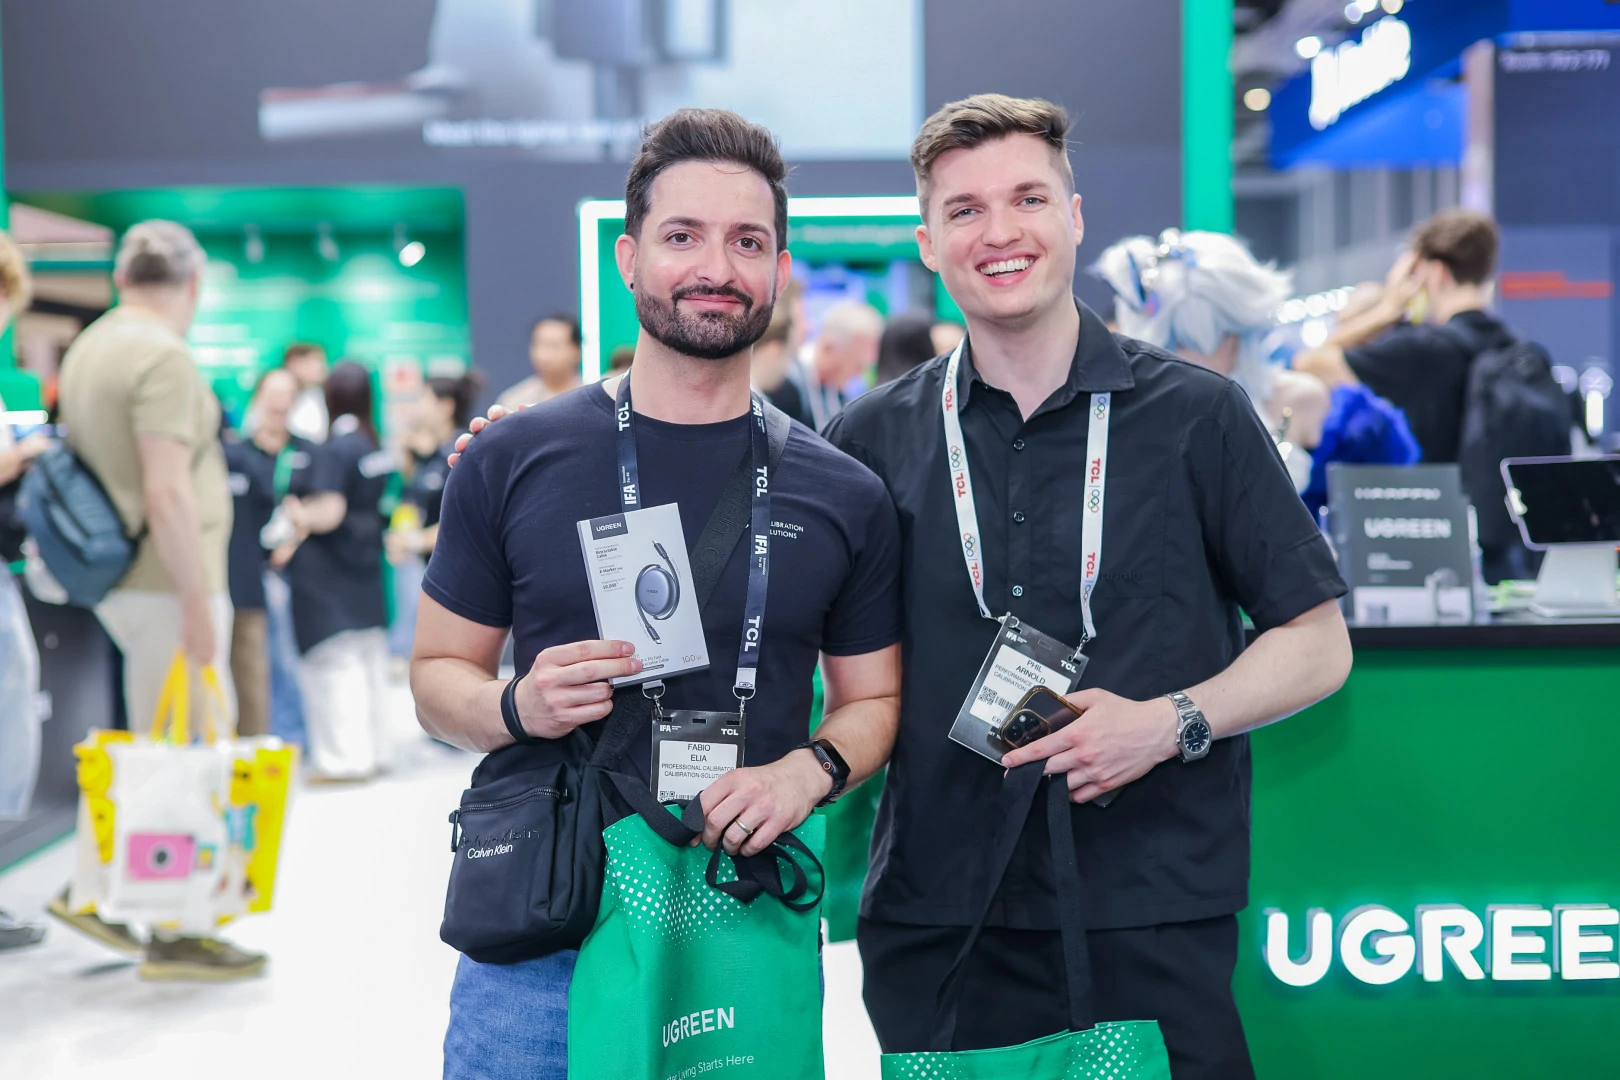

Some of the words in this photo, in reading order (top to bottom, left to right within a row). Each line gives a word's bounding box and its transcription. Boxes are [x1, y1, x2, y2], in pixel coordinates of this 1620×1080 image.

[618, 402, 630, 431] TCL
[752, 400, 763, 416] IFA
[1091, 458, 1100, 483] TCL
[757, 466, 767, 497] TCL
[955, 473, 966, 497] TCL
[623, 484, 636, 505] IFA
[596, 522, 621, 531] UGREEN
[770, 529, 797, 539] LUTIONS
[771, 521, 804, 532] LIBRATION
[755, 535, 767, 555] IFA
[1086, 552, 1095, 578] TCL
[971, 563, 980, 588] TCL
[744, 616, 760, 652] TCL
[1006, 631, 1017, 642] IFA
[995, 664, 1032, 687] PERFORMANCE
[1016, 666, 1046, 684] ARNOLD
[1026, 660, 1043, 672] PHIL
[1060, 660, 1076, 673] TCL
[994, 672, 1027, 692] CALIBRATION
[467, 848, 493, 859] Calvin
[494, 843, 513, 856] Klein
[663, 1007, 734, 1047] UGREEN
[698, 1059, 723, 1073] Starts
[726, 1055, 754, 1066] Here
